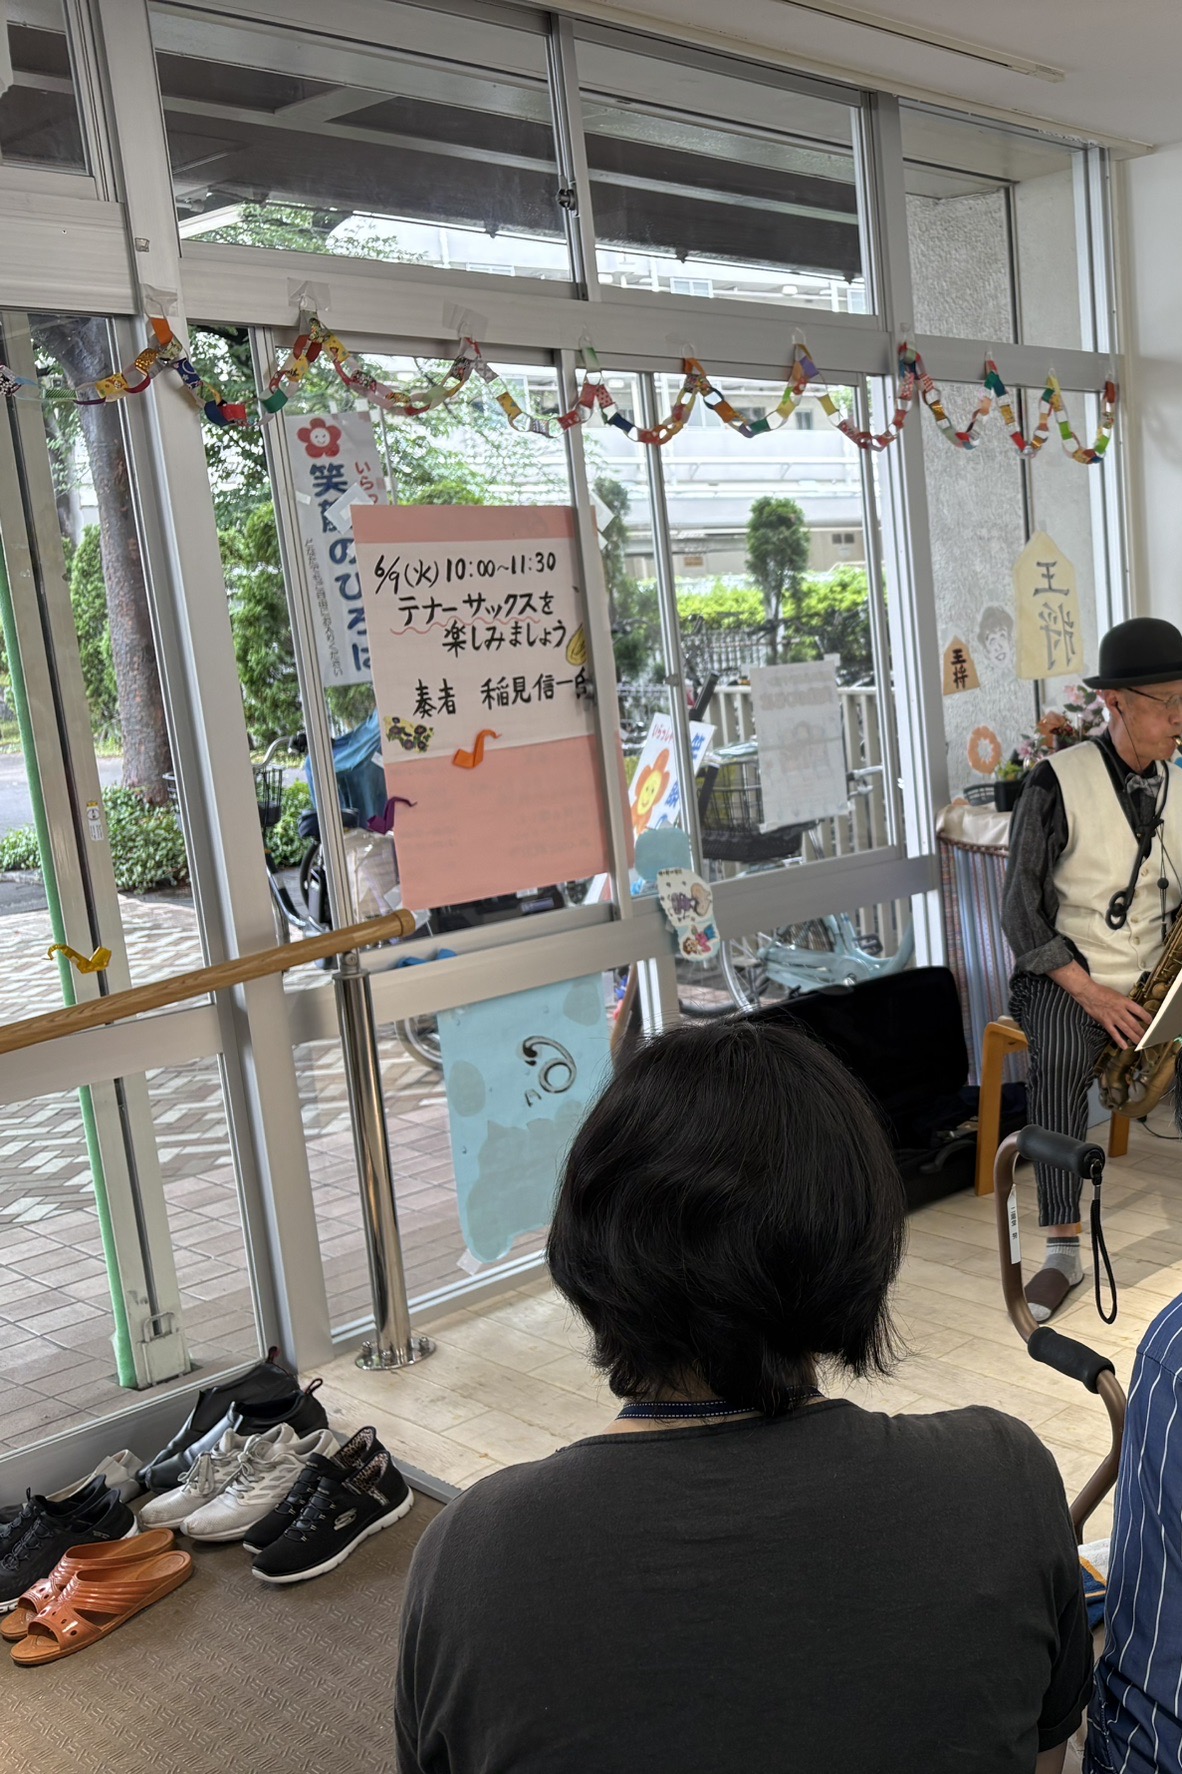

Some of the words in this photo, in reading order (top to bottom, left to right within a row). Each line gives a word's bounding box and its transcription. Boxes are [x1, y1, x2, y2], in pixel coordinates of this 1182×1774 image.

[397, 591, 556, 628] テナーサックスを
[442, 619, 567, 658] 楽しみましょう
[951, 648, 968, 689] 王将
[412, 678, 457, 718] 奏者
